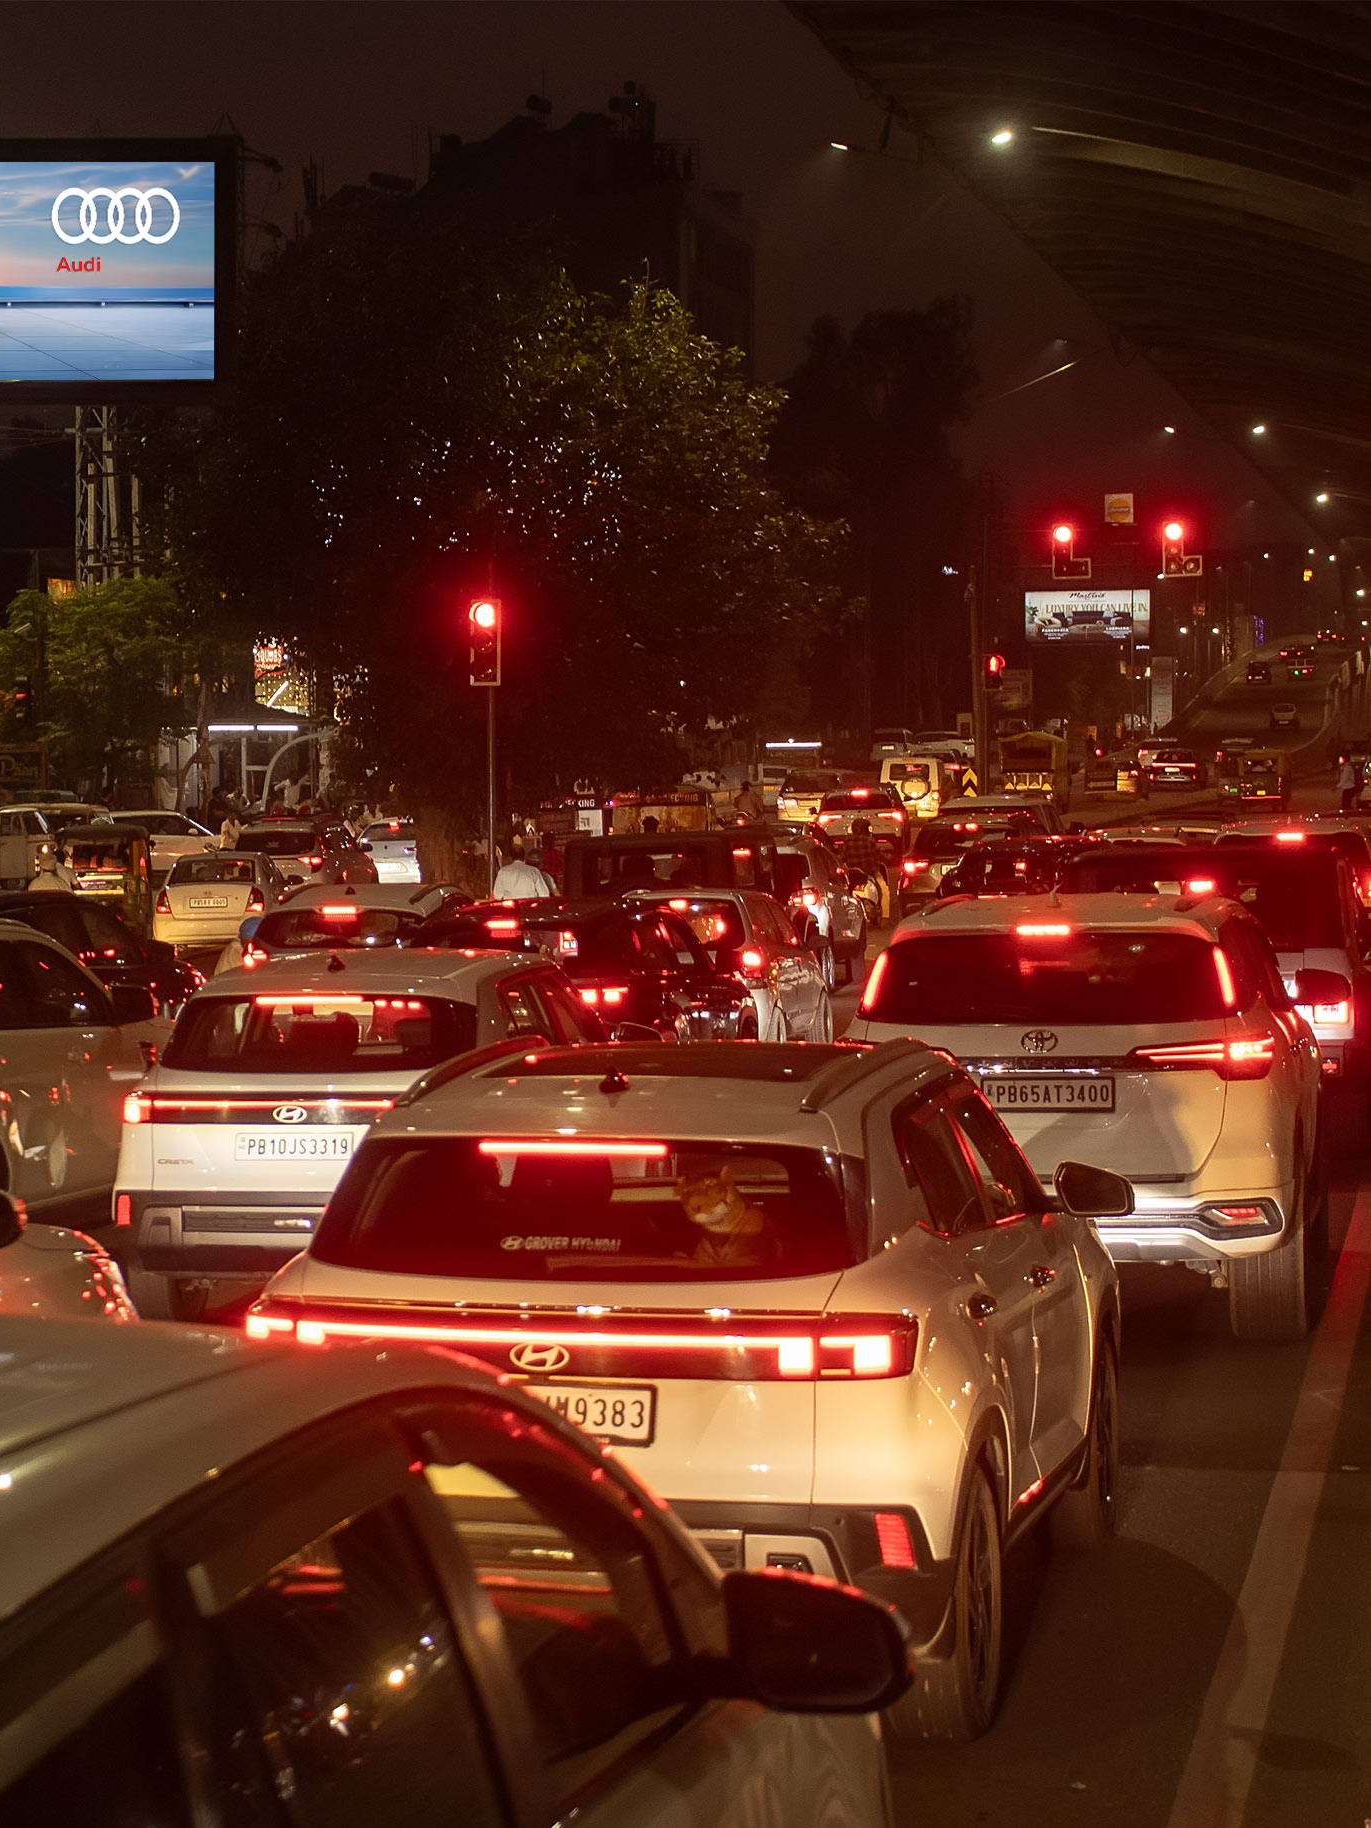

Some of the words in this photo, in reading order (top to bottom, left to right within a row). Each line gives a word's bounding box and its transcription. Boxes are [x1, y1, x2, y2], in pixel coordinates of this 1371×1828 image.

[56, 256, 101, 273] Audi
[1081, 603, 1098, 612] YOU
[1100, 603, 1117, 612] CAN
[996, 1084, 1109, 1103] PB65AT3400
[247, 1138, 348, 1155] PB10JS3319
[525, 1236, 569, 1250] GROVER
